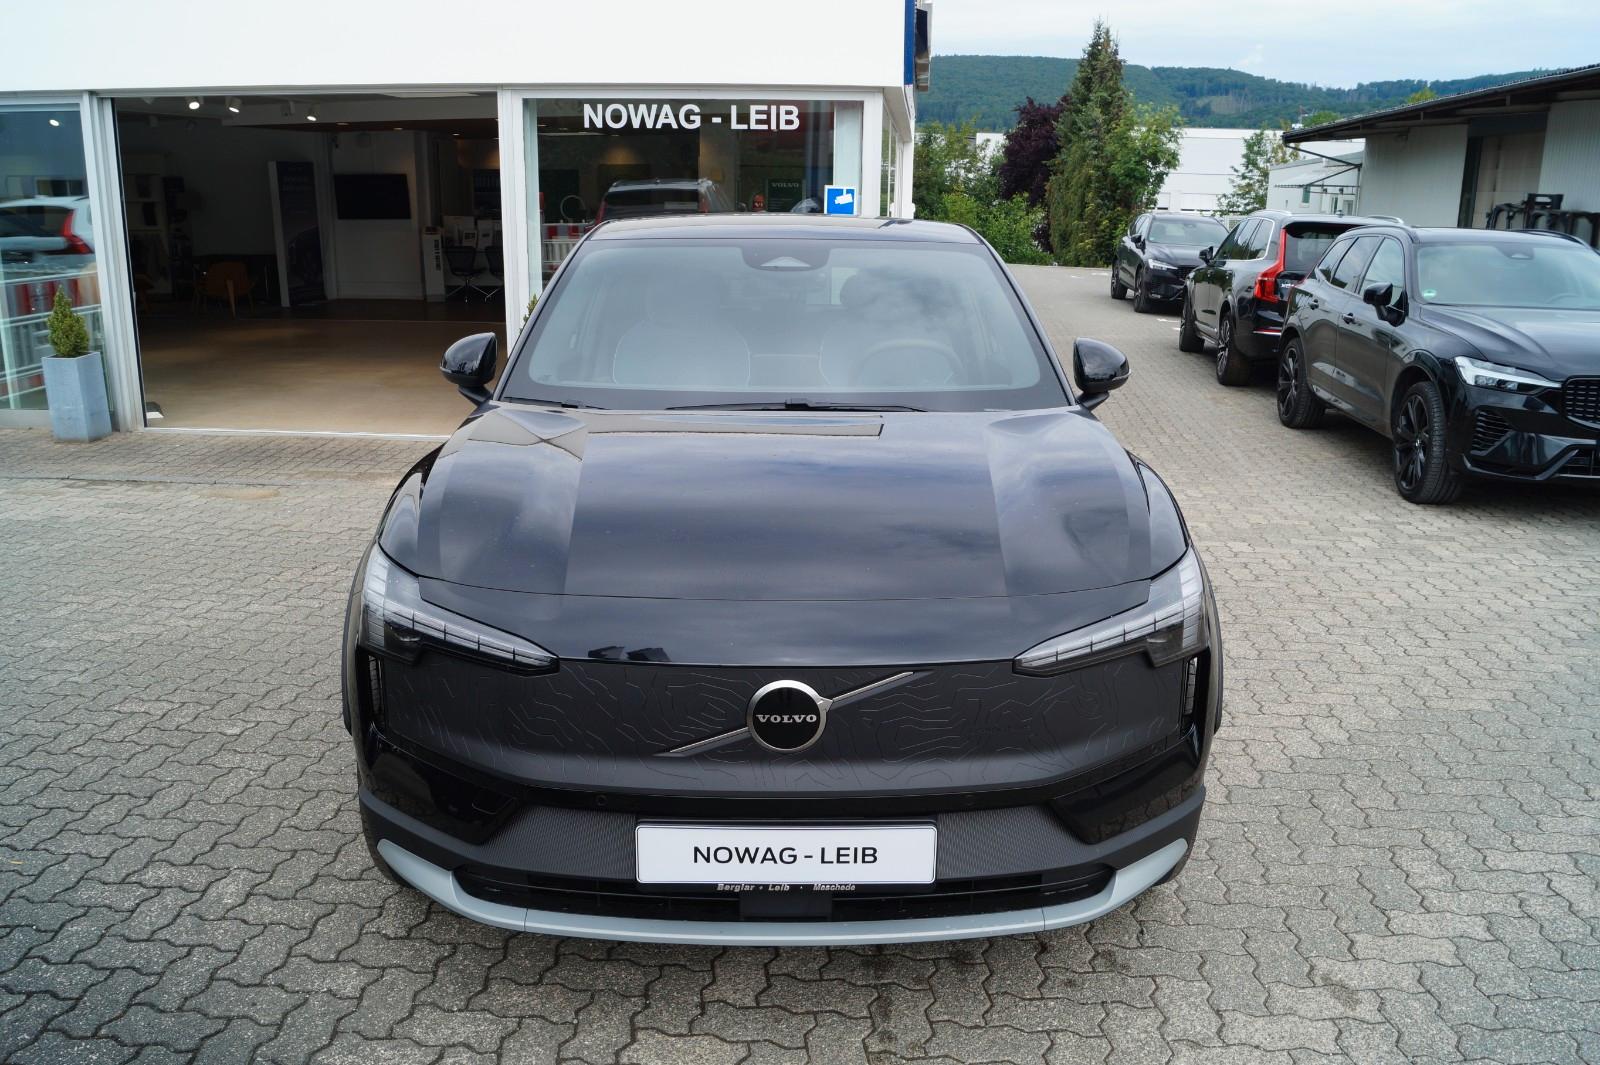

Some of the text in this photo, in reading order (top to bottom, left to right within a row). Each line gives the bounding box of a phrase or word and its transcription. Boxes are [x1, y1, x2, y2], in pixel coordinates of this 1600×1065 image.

[582, 103, 702, 130] NOWAG
[730, 104, 800, 131] LEIB
[770, 181, 800, 189] VOLVO
[756, 714, 818, 724] VOLVO
[693, 846, 798, 865] NOWAG
[820, 846, 878, 865] LEIB
[768, 883, 790, 892] Leib
